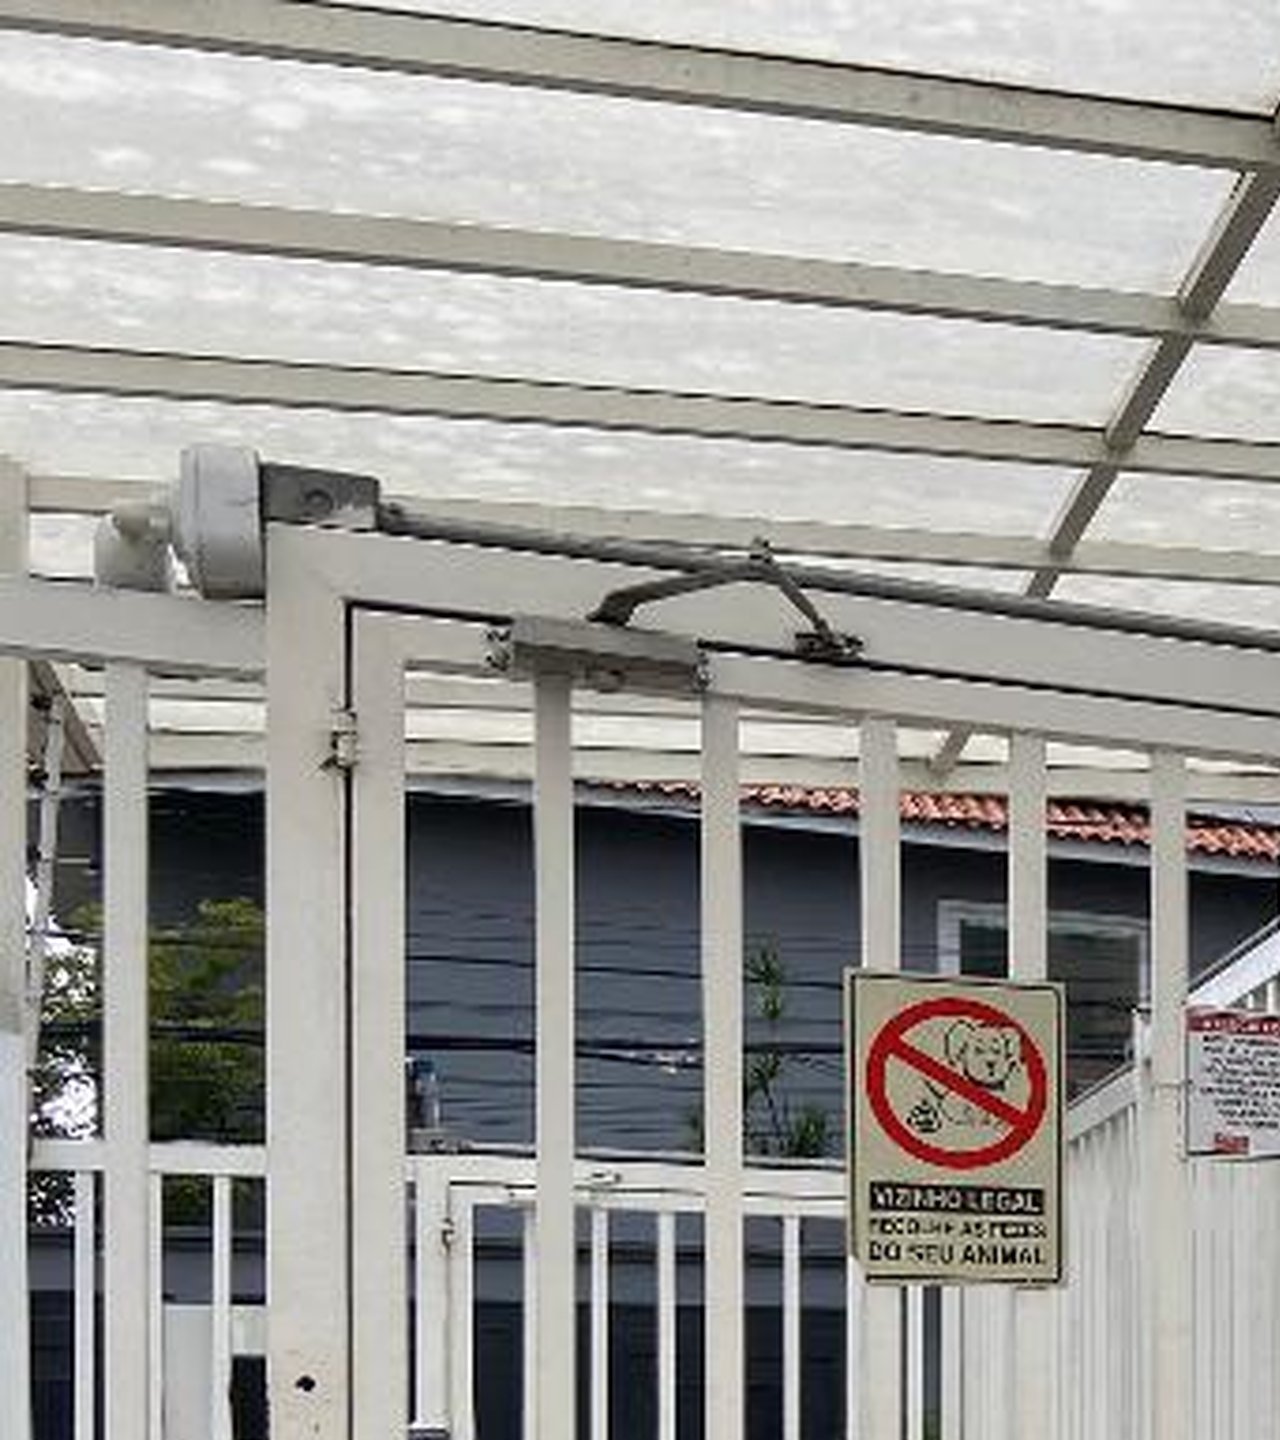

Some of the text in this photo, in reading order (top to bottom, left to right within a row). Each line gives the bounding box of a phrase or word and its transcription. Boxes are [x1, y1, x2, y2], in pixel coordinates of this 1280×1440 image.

[873, 1186, 1040, 1213] VIZINHO LEGAL
[869, 1240, 901, 1262] DO
[961, 1244, 1046, 1267] ANIMAL
